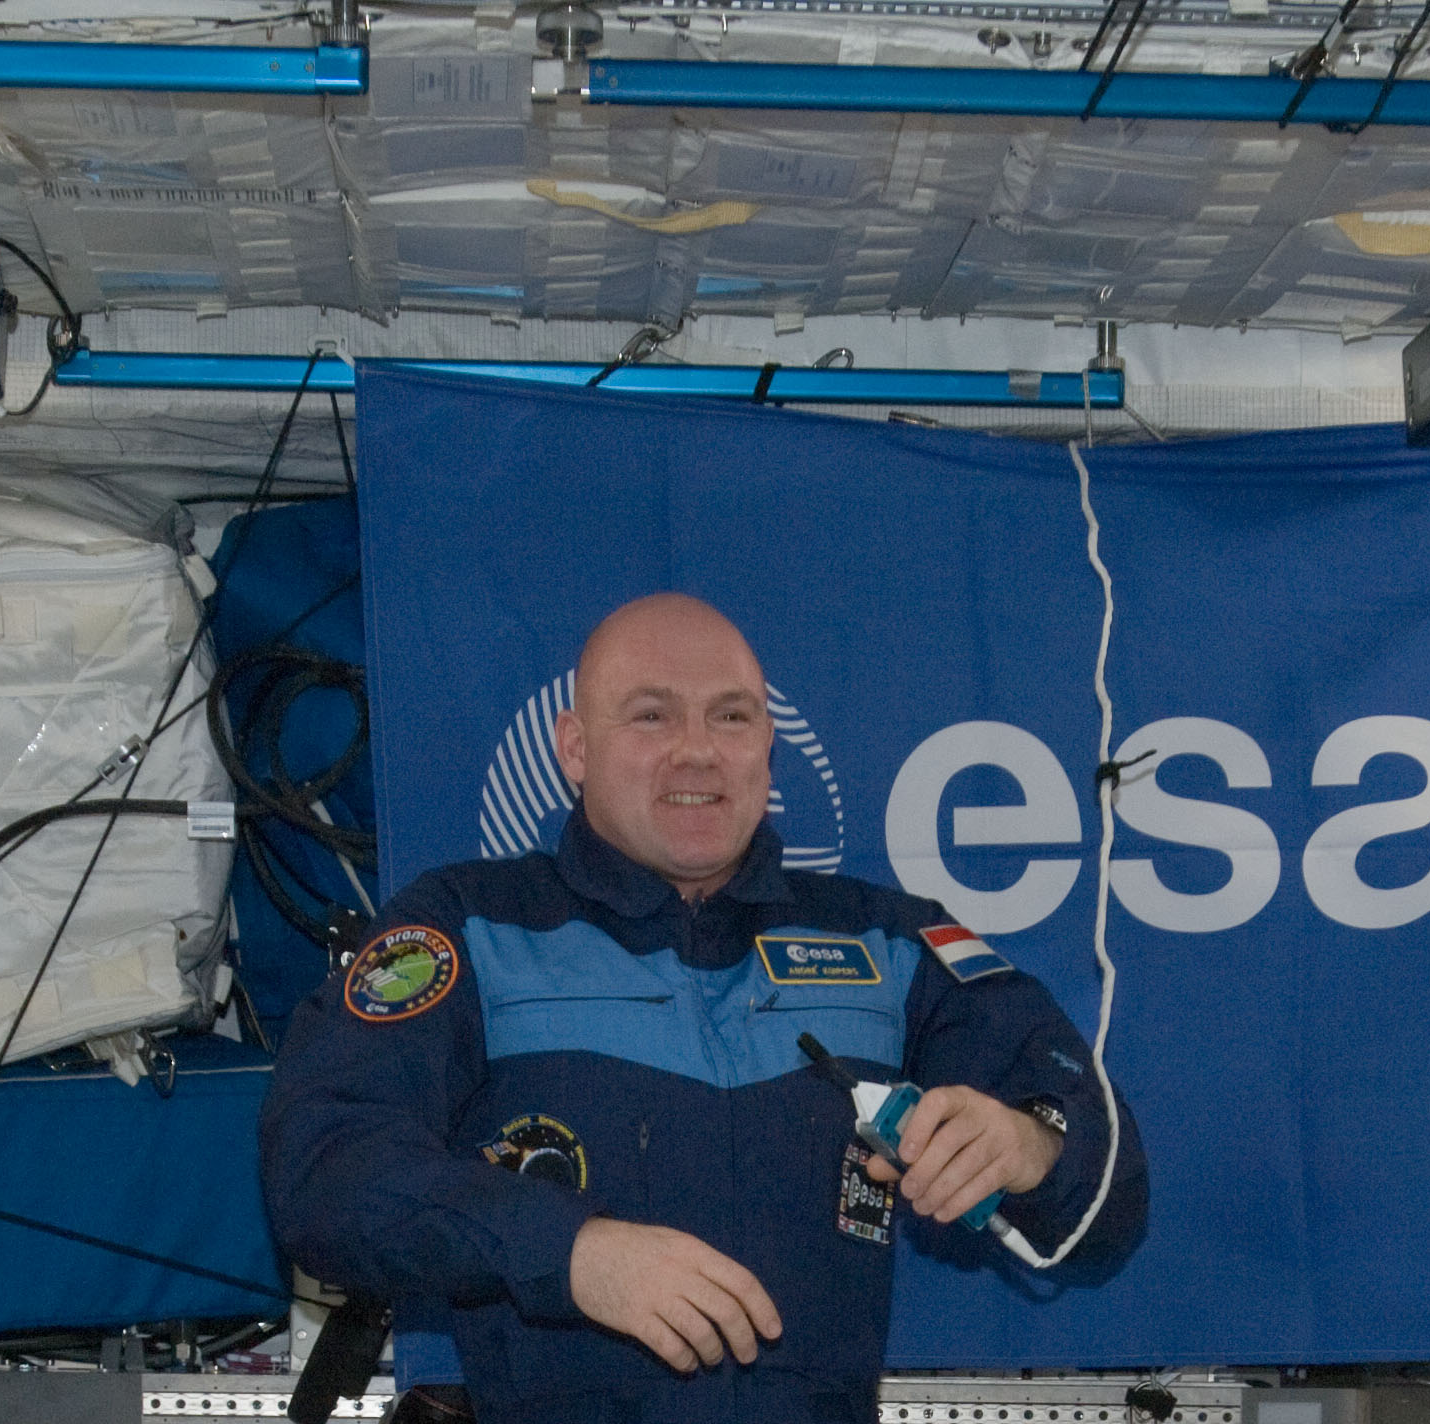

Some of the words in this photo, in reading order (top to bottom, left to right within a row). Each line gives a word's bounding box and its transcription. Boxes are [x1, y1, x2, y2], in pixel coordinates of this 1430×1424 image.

[385, 930, 450, 960] promisse
[809, 948, 845, 961] esa
[860, 1183, 884, 1208] esa
